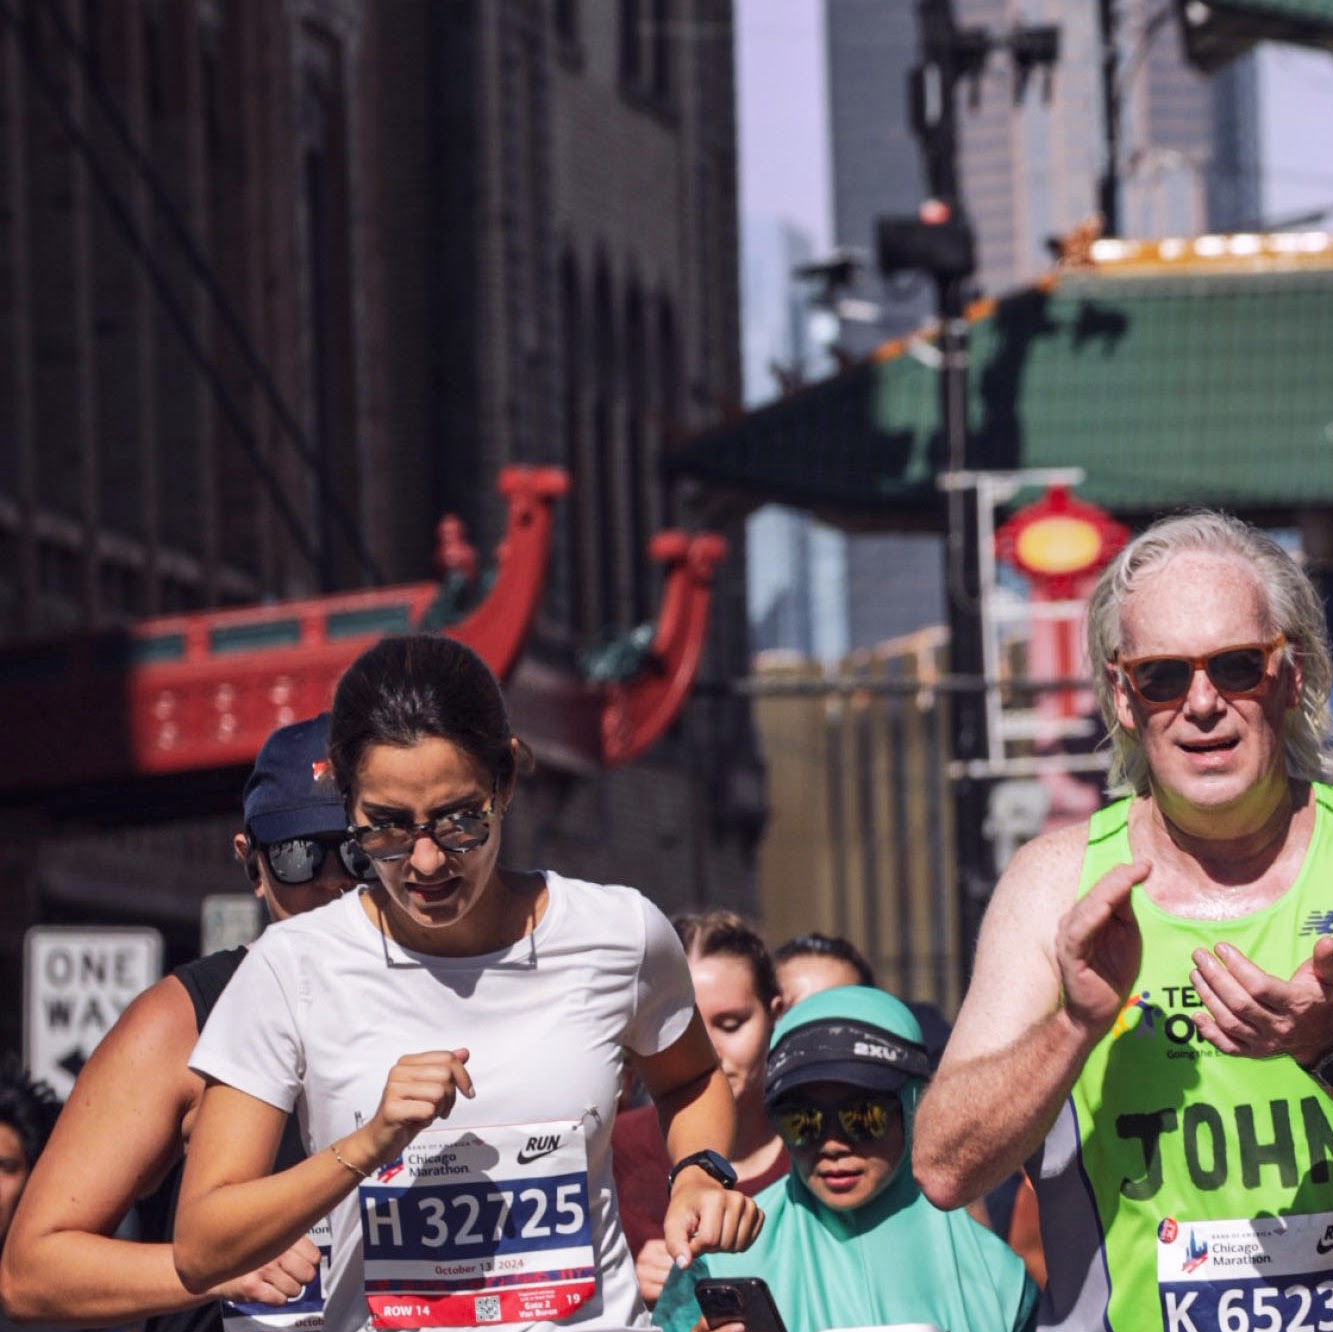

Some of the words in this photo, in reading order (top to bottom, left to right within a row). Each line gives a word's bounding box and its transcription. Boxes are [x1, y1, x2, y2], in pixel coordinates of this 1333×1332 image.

[46, 948, 137, 988] ONE
[1162, 986, 1203, 1008] TE
[853, 1041, 897, 1061] 2XU
[525, 1134, 561, 1151] RUN
[408, 1153, 457, 1168] Chicago
[409, 1164, 469, 1178] Marathon
[365, 1197, 403, 1246] H
[418, 1183, 585, 1248] 32725
[1212, 1243, 1259, 1255] Chicago
[434, 1265, 476, 1275] October
[498, 1258, 525, 1270] 2024
[1213, 1255, 1271, 1266] Marathon
[566, 1293, 581, 1305] 19
[383, 1305, 412, 1317] ROW
[416, 1304, 431, 1316] 14
